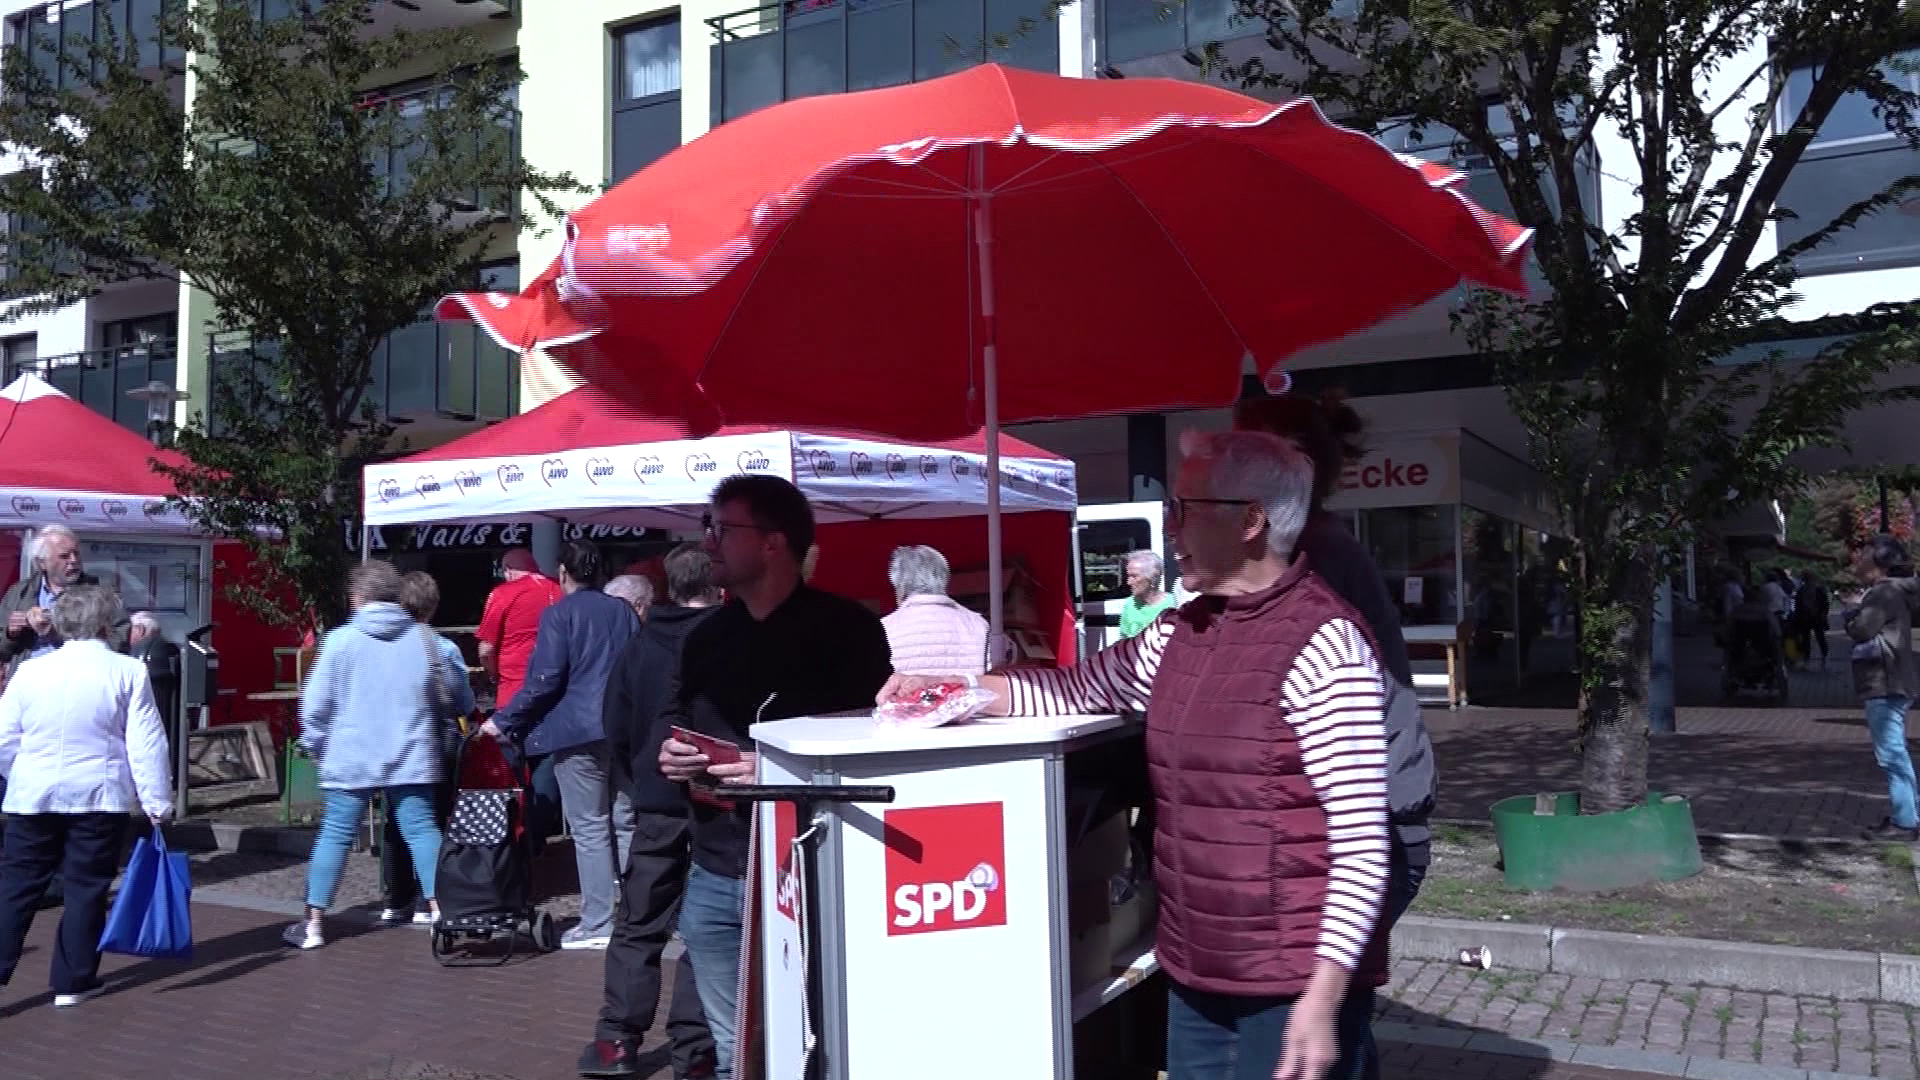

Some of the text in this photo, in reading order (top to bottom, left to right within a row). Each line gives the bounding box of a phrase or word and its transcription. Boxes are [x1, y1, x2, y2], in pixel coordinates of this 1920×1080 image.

[548, 467, 569, 479] AWO
[593, 465, 614, 476] AWO
[641, 463, 664, 475] AWO
[694, 460, 717, 472] AWO
[1338, 457, 1429, 489] Ecke
[499, 523, 527, 545] &
[894, 880, 987, 927] SPD
